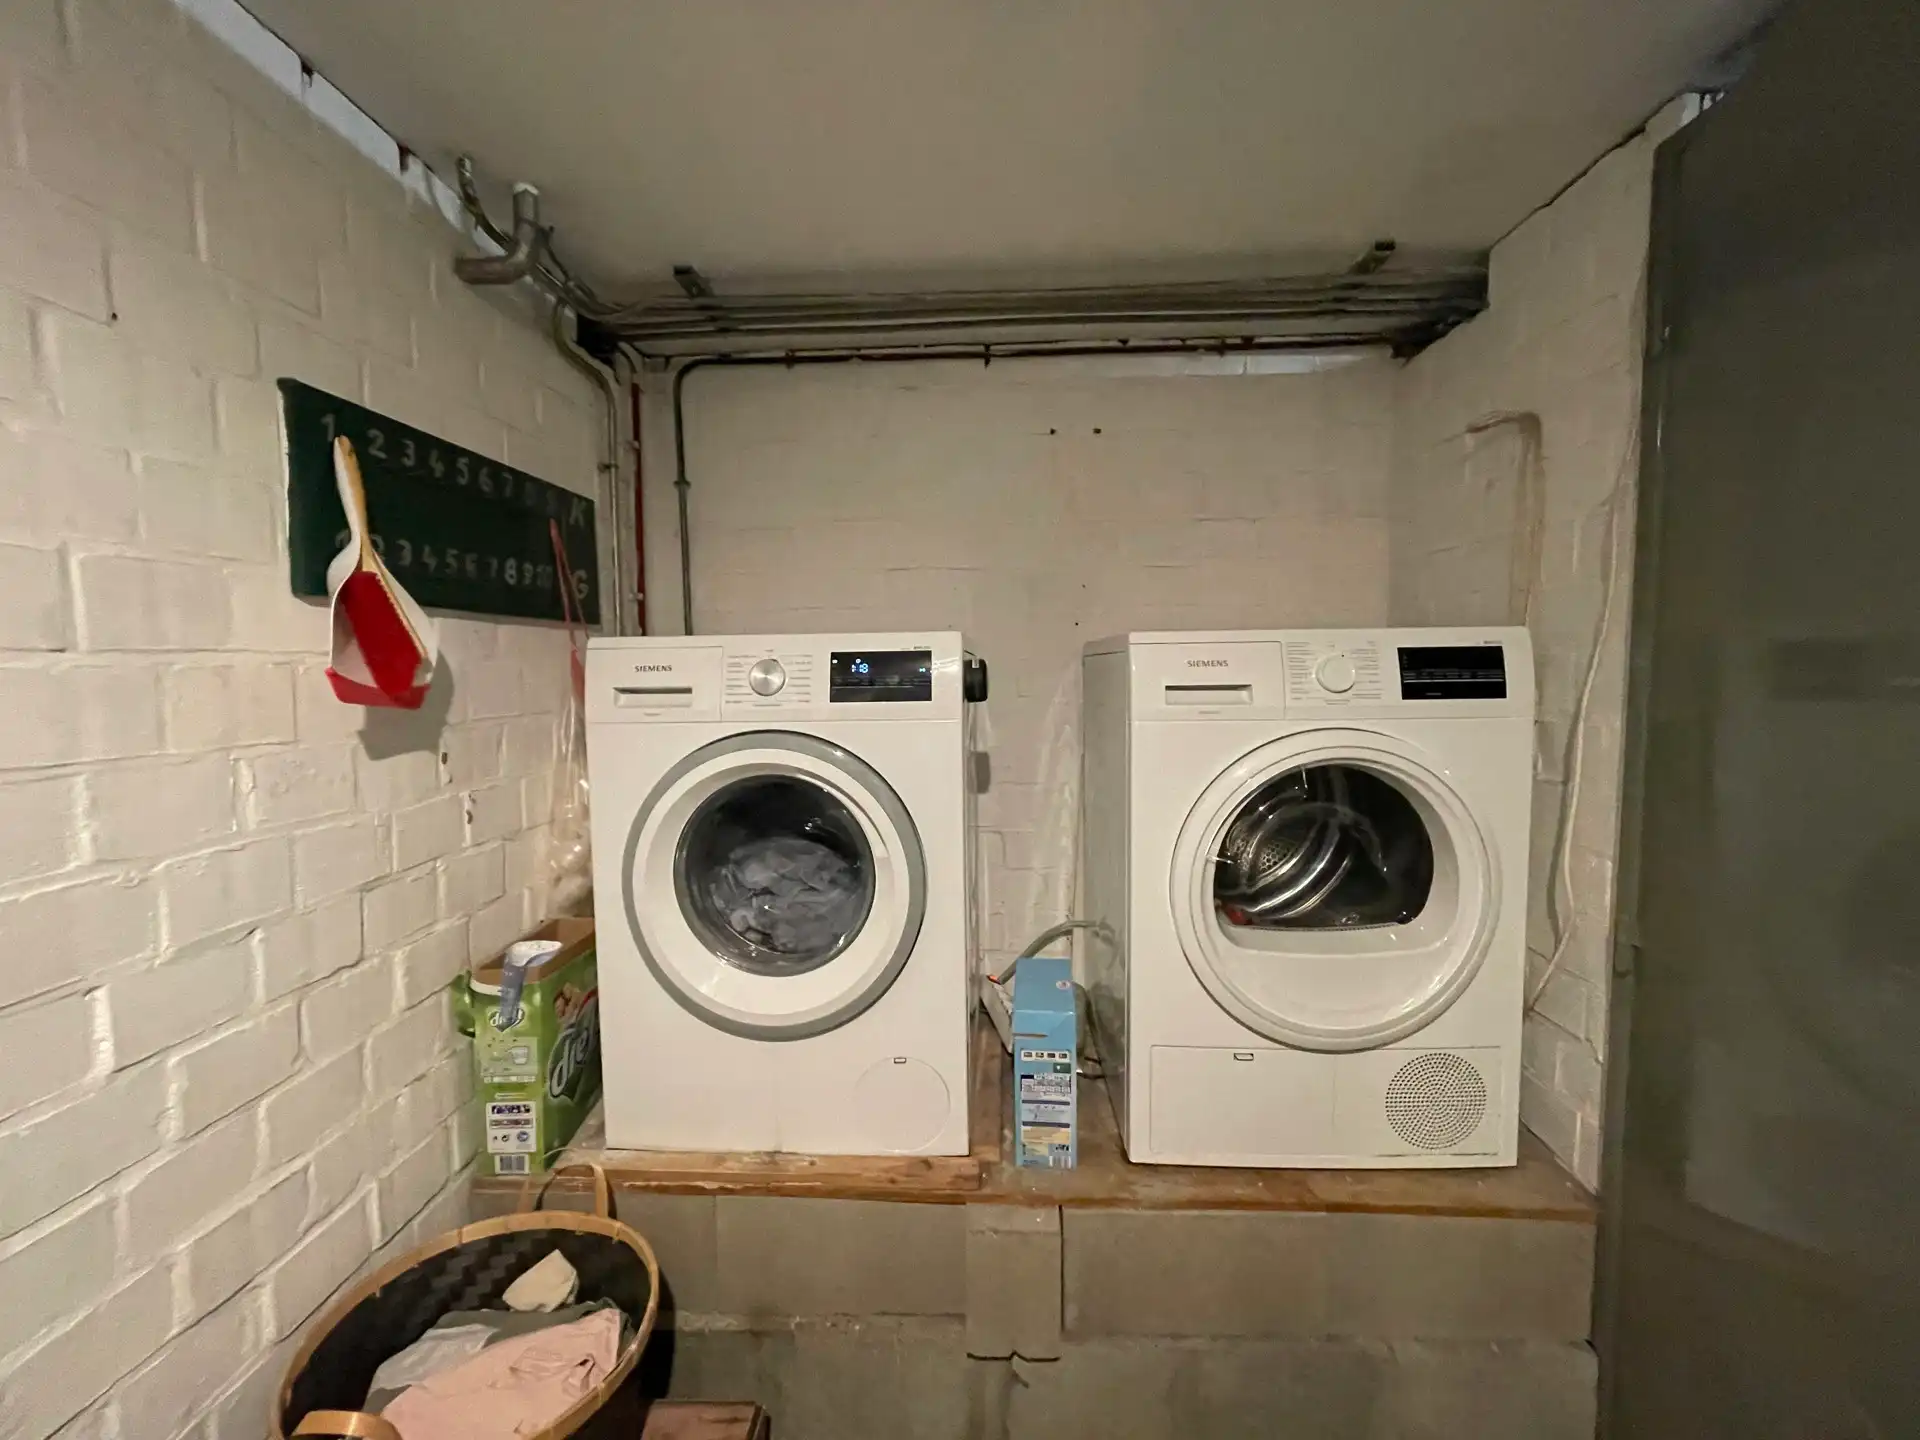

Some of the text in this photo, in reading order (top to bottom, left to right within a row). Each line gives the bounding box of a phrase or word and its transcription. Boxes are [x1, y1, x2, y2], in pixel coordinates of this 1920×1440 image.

[320, 413, 336, 442] 1
[366, 428, 388, 459] 2
[400, 438, 415, 467] 3
[428, 449, 445, 477] 4
[455, 456, 469, 485] 5
[478, 466, 494, 493] 6
[502, 471, 514, 498] 7
[569, 496, 587, 527] K
[395, 538, 412, 568] 3
[421, 544, 439, 573] 4
[444, 547, 460, 576] 5
[504, 556, 517, 585] 8
[572, 569, 589, 600] G
[634, 664, 672, 673] SIEMENS
